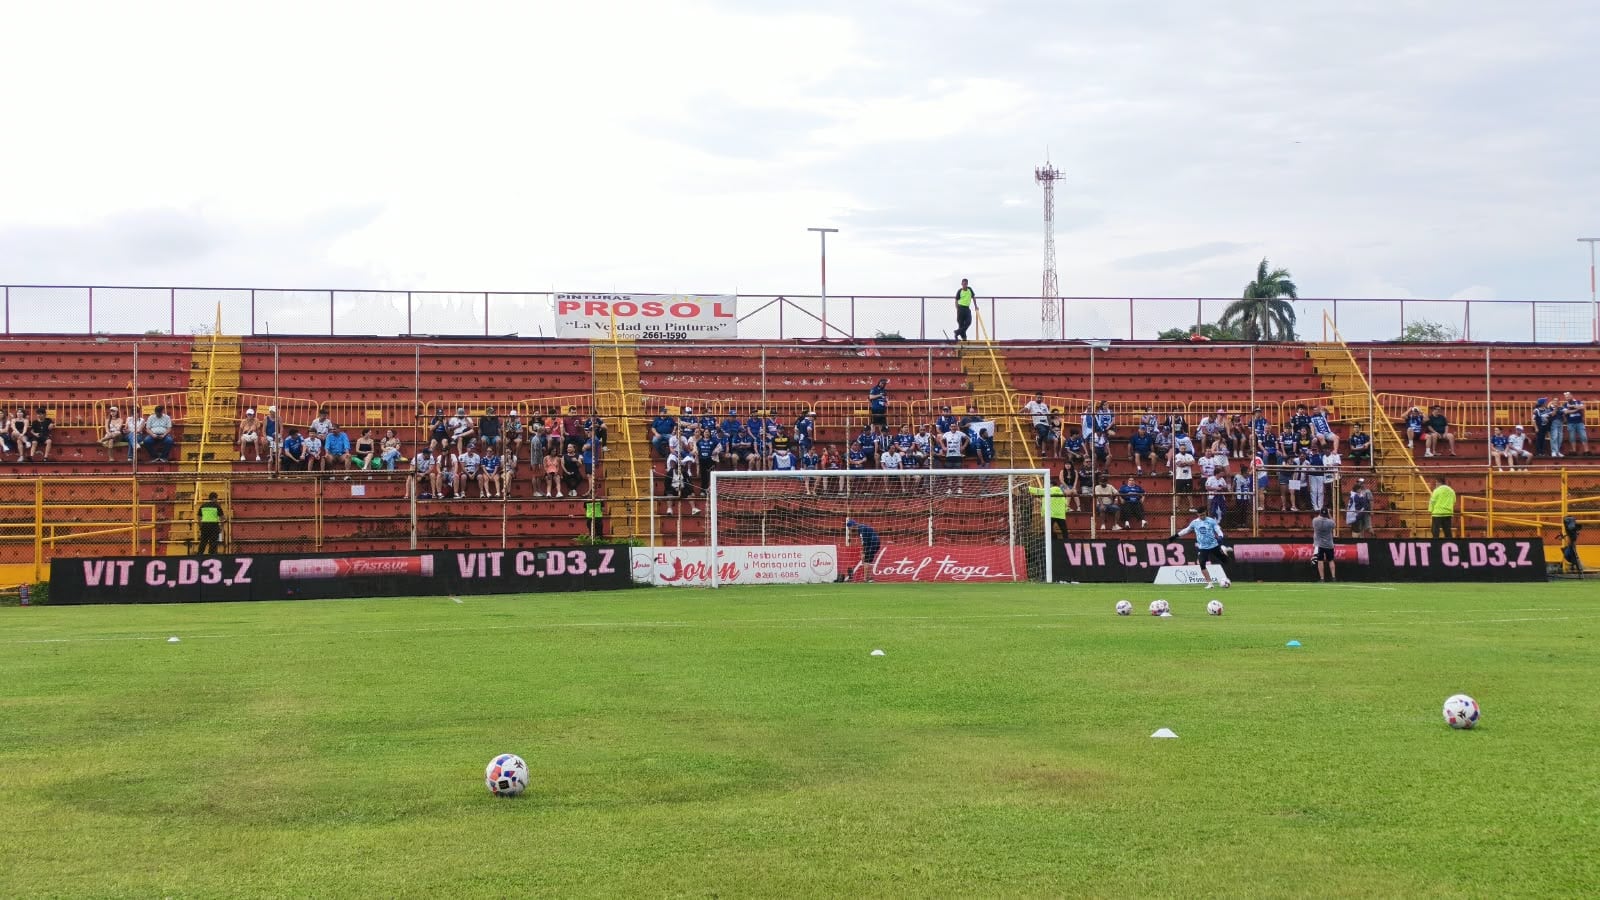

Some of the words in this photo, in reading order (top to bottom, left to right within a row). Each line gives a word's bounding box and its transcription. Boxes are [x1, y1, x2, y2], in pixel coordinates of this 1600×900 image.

[558, 301, 734, 318] PROSOL
[642, 331, 687, 340] 2661-1590
[456, 551, 505, 578] VIT
[743, 562, 749, 570] y
[747, 551, 803, 559] Restaurante
[853, 546, 932, 581] Hotel
[1064, 542, 1107, 567] VIT
[1388, 542, 1431, 567] VIT
[83, 560, 134, 586] VIT
